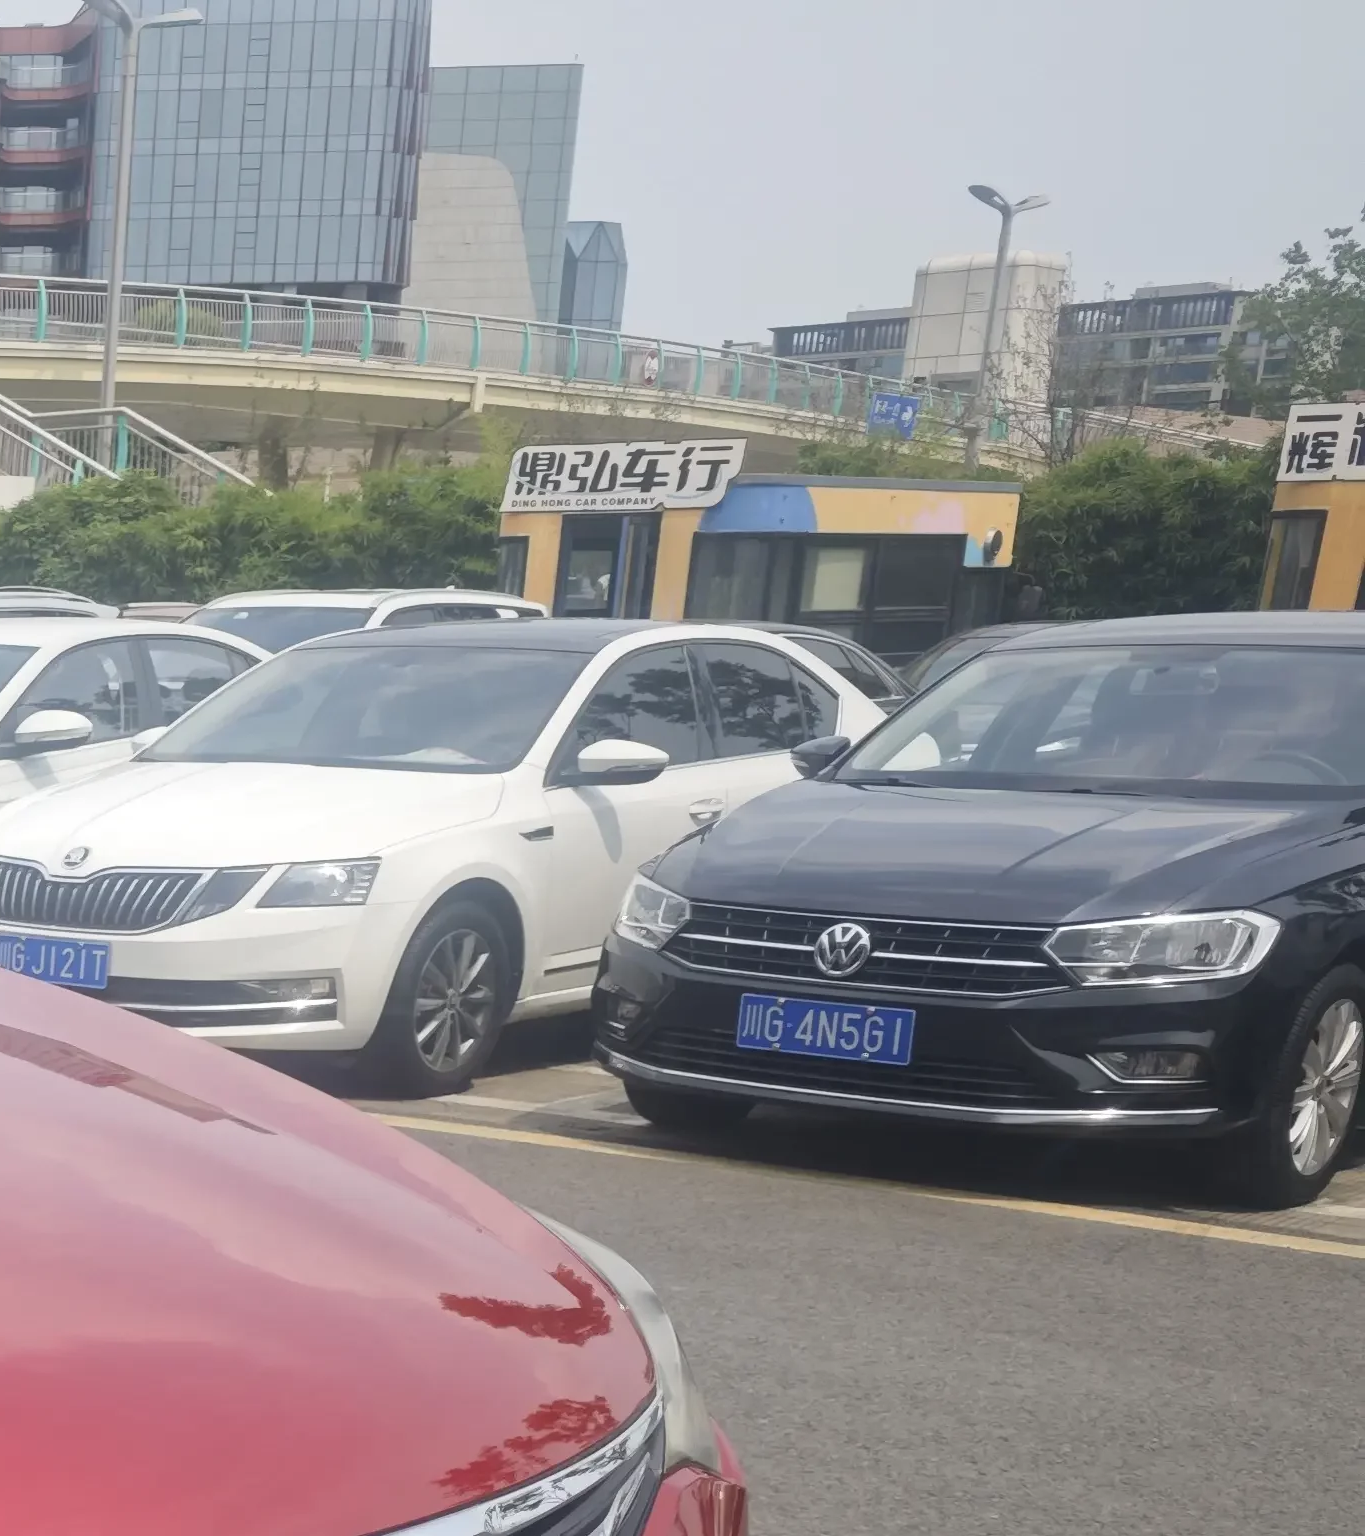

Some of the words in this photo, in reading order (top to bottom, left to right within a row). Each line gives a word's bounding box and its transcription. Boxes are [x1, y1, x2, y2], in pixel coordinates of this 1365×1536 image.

[515, 446, 734, 495] 鼎弘车行
[511, 499, 537, 508] DING
[575, 498, 597, 507] CAR
[601, 497, 656, 506] COMPANY
